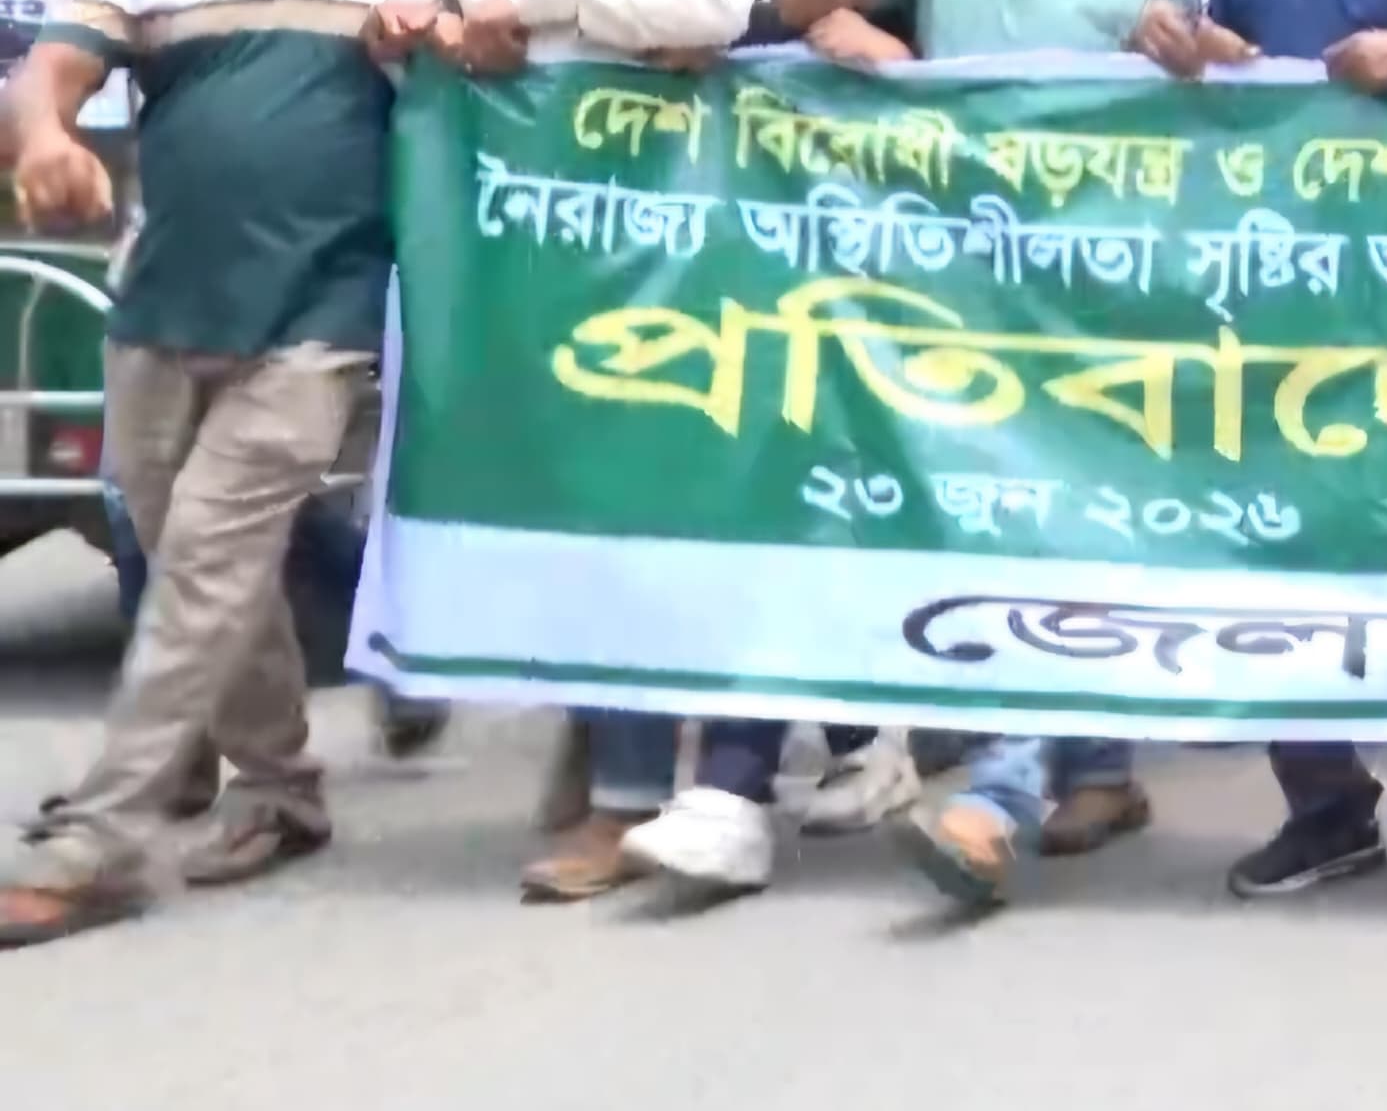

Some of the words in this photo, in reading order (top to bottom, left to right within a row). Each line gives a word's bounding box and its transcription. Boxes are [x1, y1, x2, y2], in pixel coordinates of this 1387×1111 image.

[574, 86, 711, 166] দেশ
[986, 129, 1190, 207] ষড়যন্ত্র
[1217, 138, 1264, 197] ও
[476, 152, 722, 260] নৈরাজ্য
[739, 182, 1161, 293] অস্থিতিশীলতা
[1186, 207, 1351, 321] সৃষ্টির
[803, 466, 904, 520] ২৩
[931, 471, 1070, 536] জুন
[1083, 487, 1299, 547] ২০২৬
